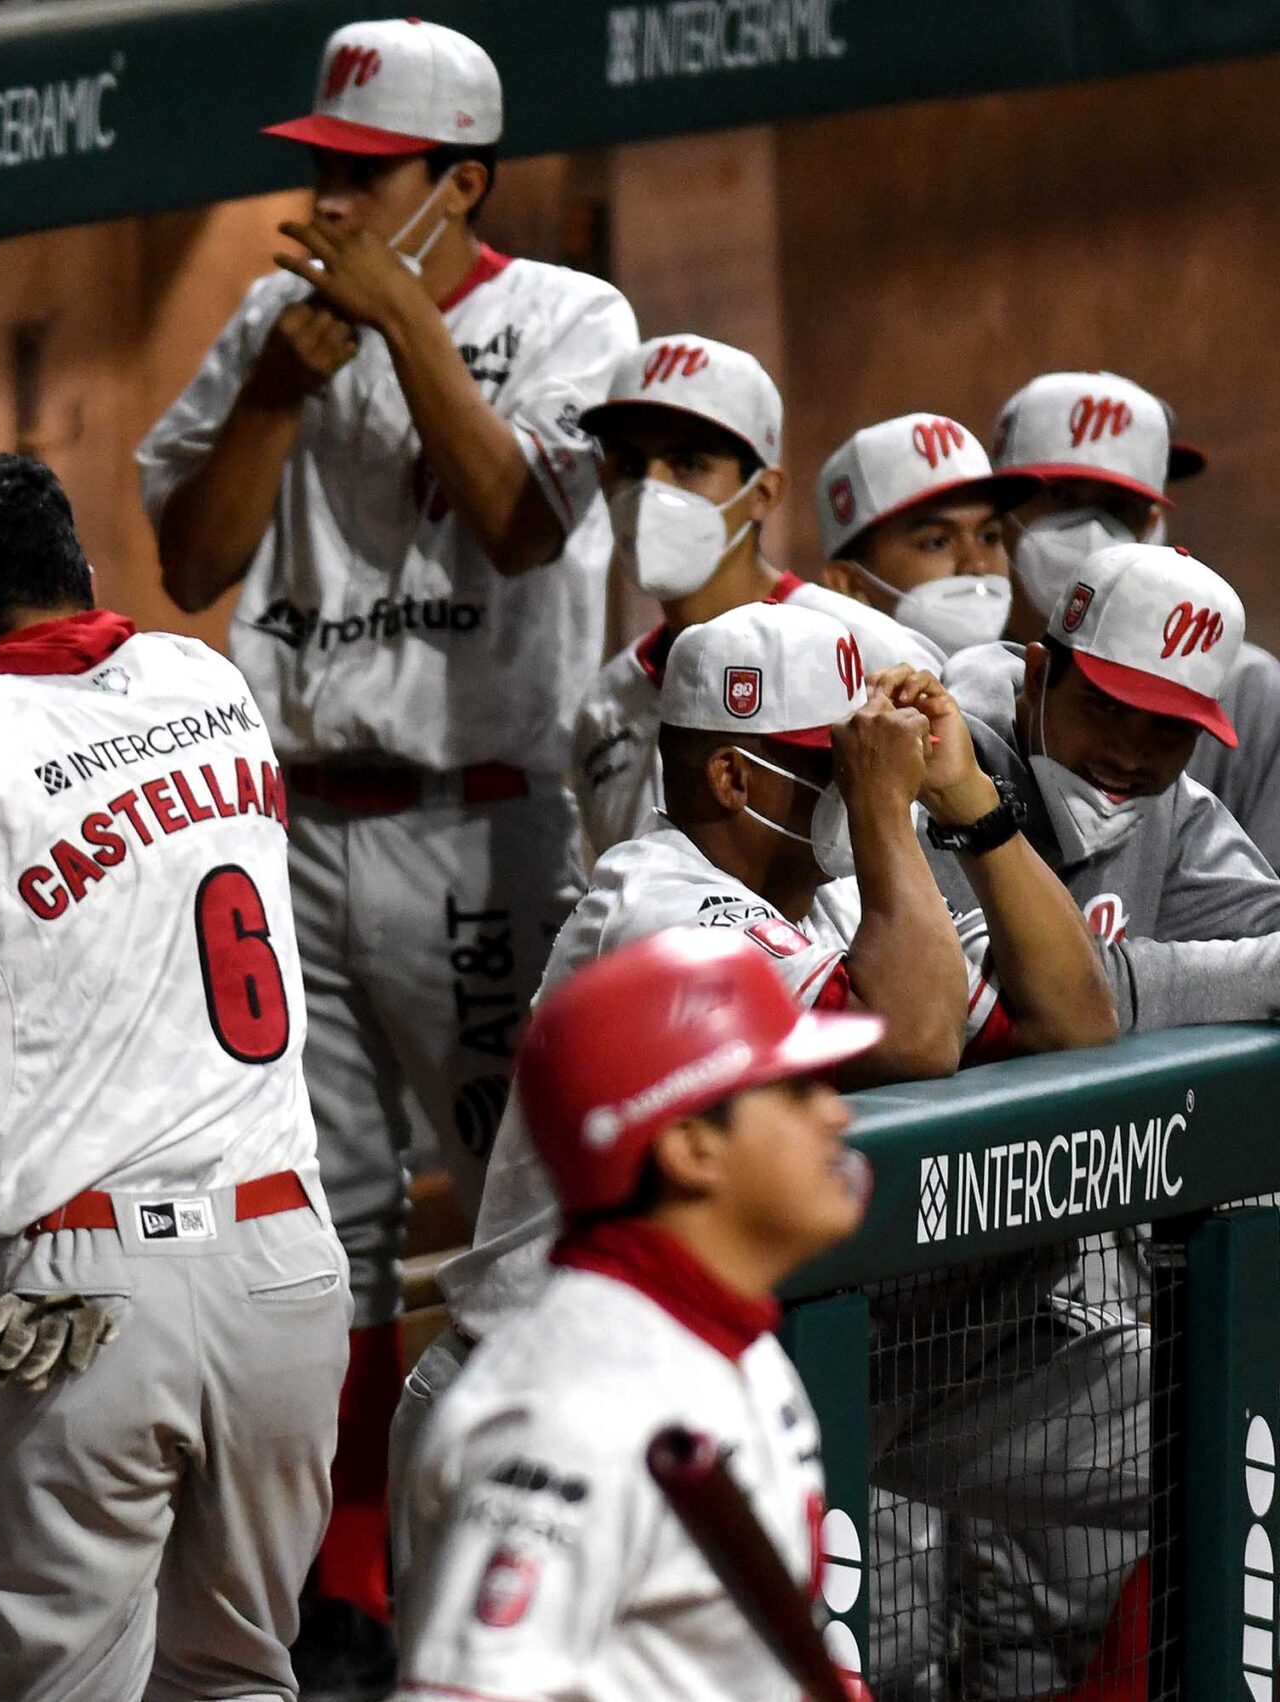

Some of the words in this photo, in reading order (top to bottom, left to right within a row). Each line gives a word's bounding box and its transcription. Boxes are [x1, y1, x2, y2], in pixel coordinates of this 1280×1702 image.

[67, 700, 261, 781] INTERCERAMIC
[732, 681, 754, 698] 80
[194, 863, 290, 1064] 6
[446, 895, 519, 1056] AT&T
[956, 1113, 1187, 1236] INTERCERAMIC
